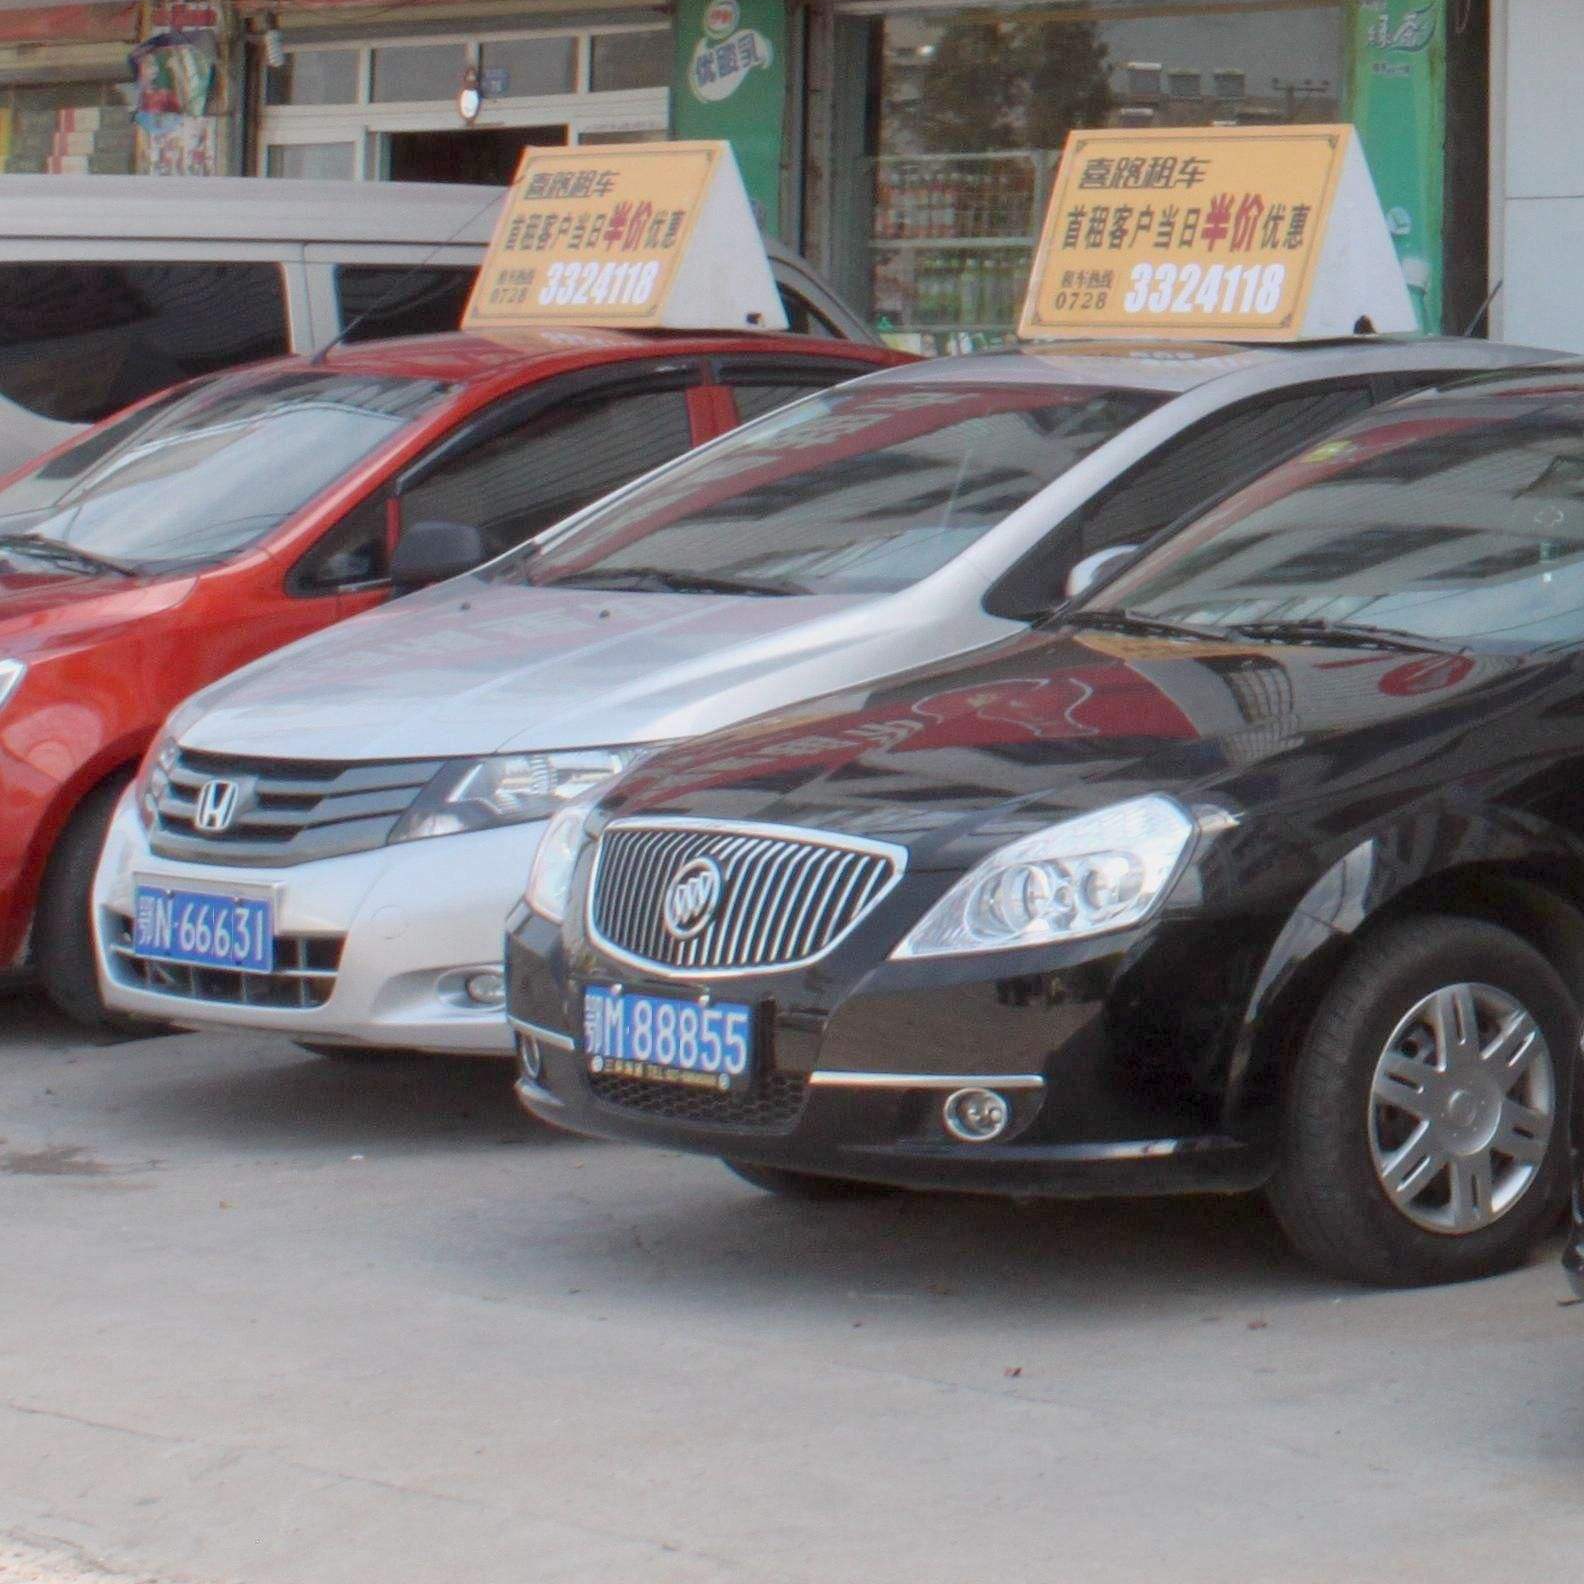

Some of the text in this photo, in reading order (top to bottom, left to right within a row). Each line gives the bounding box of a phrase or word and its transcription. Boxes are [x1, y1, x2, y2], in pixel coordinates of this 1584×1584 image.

[1078, 156, 1212, 190] 喜路租车
[538, 260, 662, 306] 3324118
[1054, 291, 1108, 311] 0728
[1123, 262, 1287, 314] 3324118
